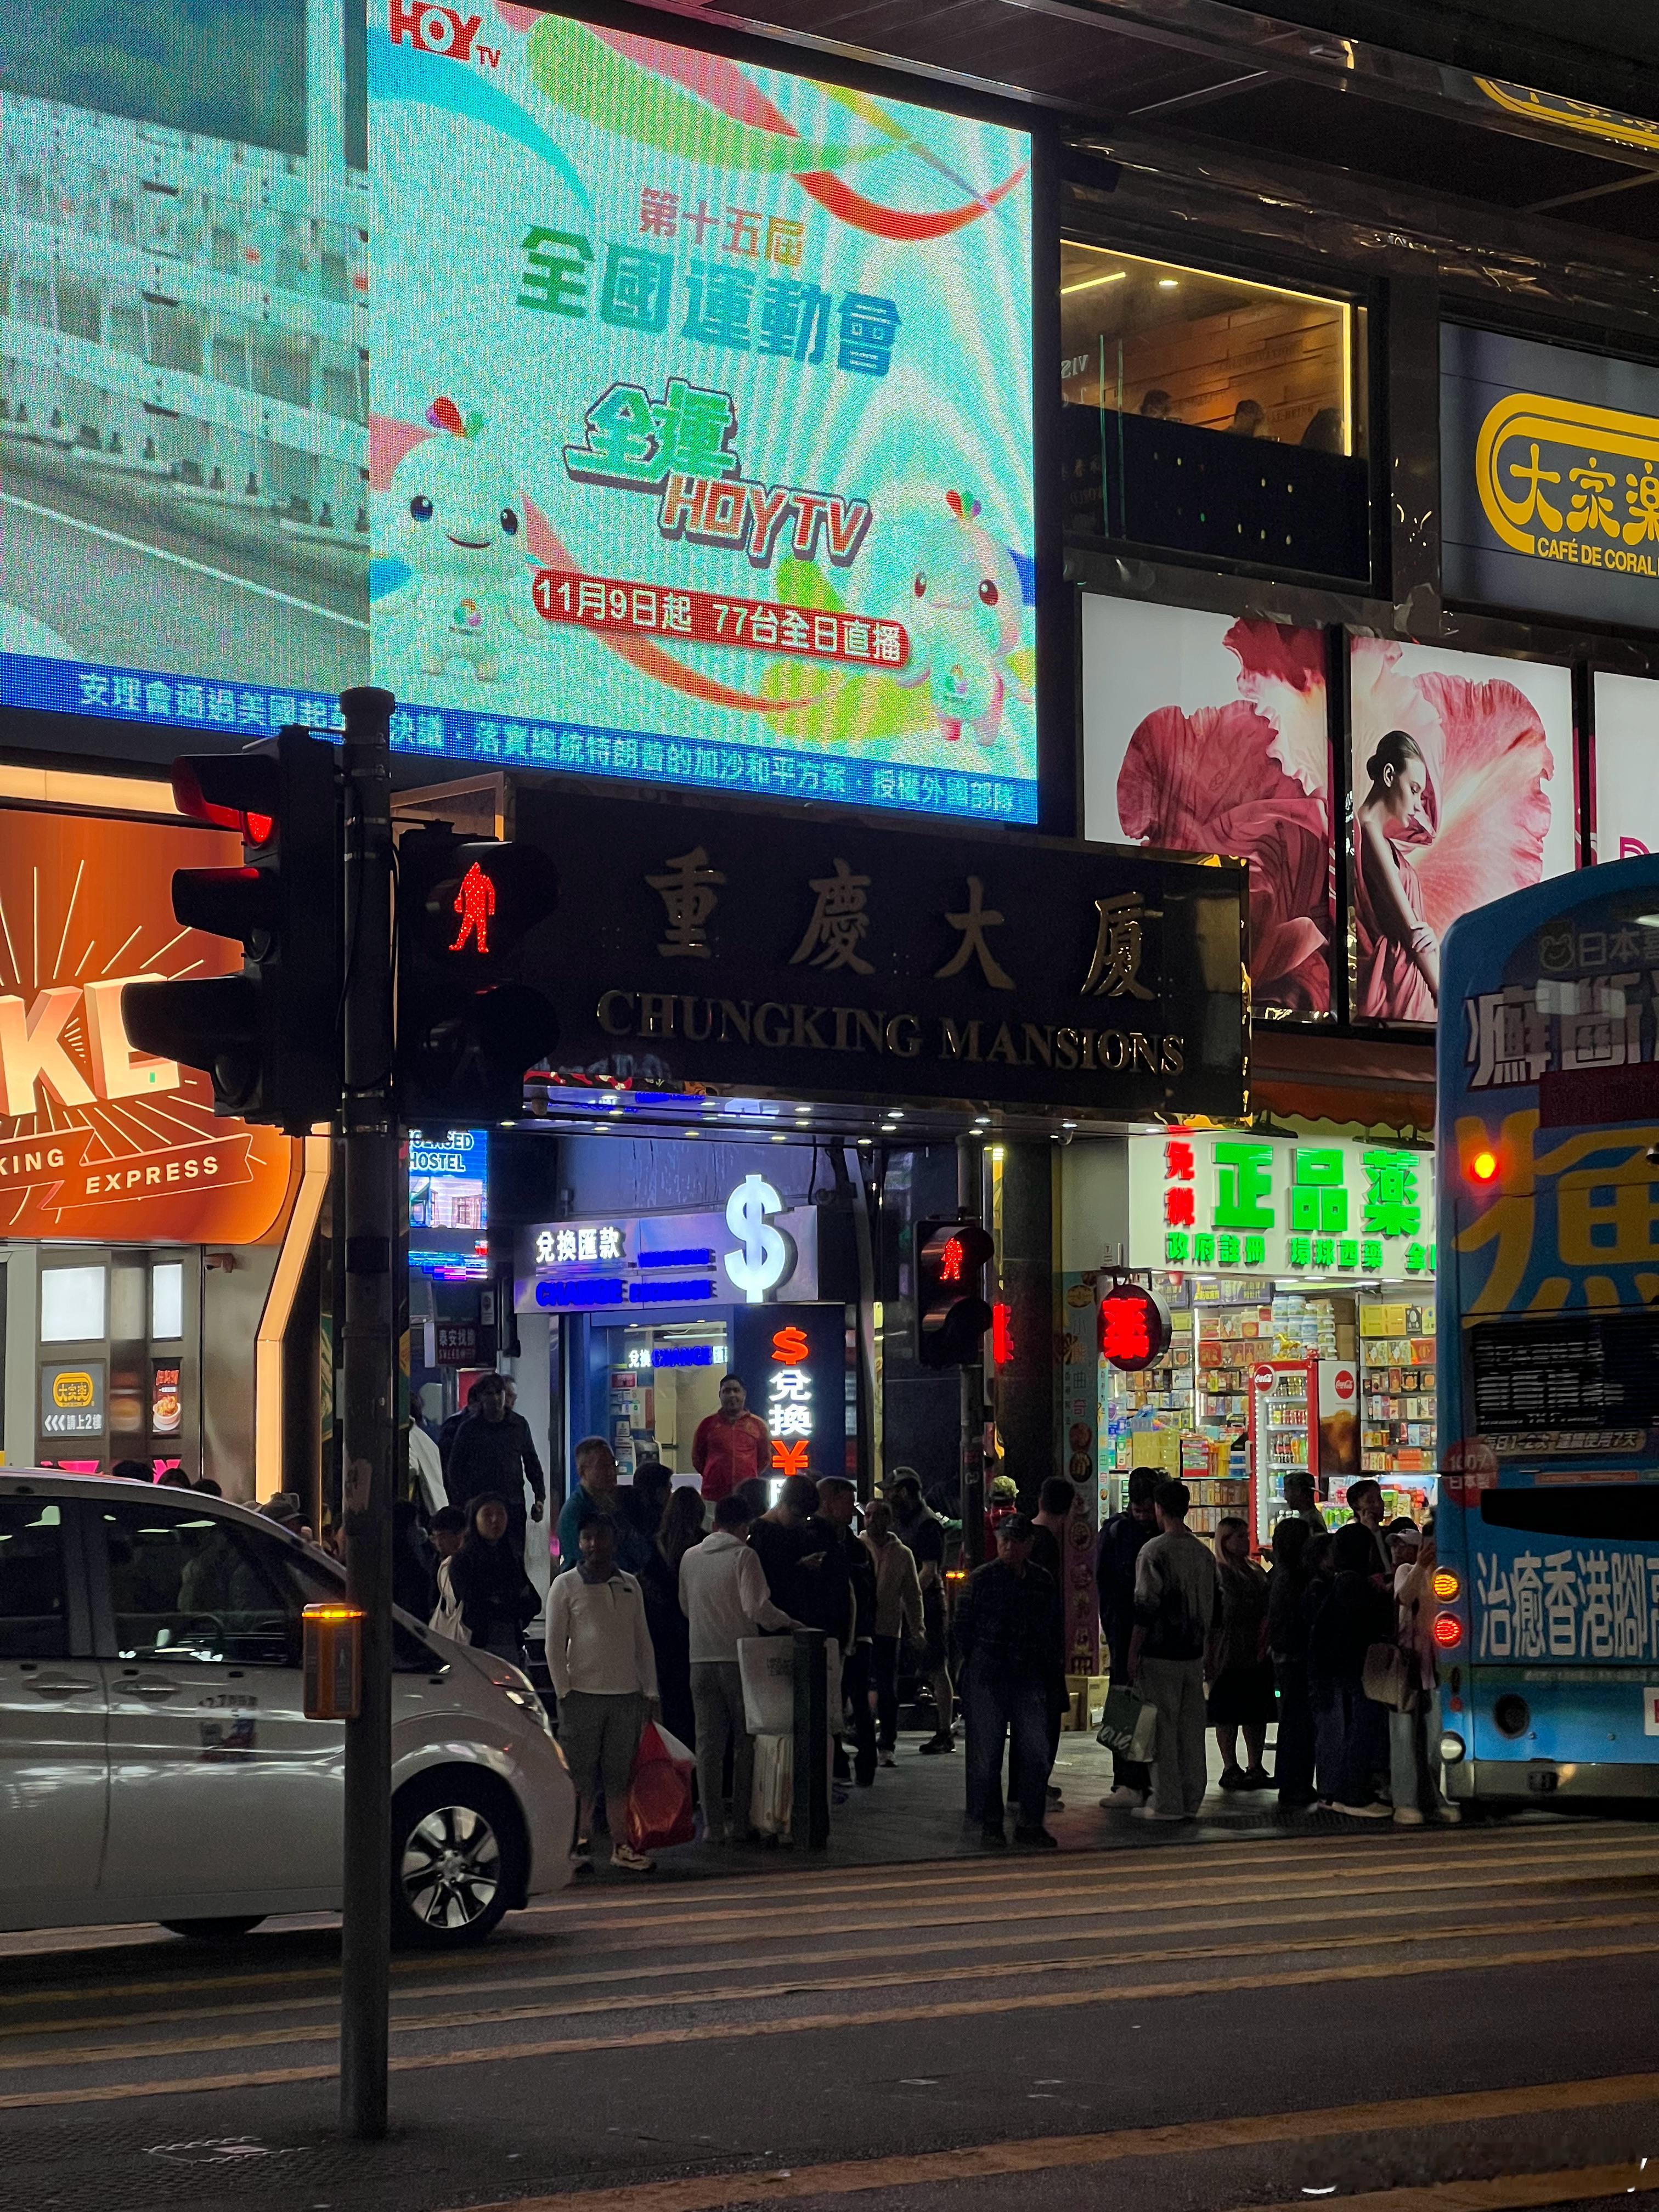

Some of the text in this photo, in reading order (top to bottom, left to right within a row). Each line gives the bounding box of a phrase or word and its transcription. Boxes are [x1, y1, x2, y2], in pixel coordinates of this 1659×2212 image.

[391, 0, 500, 67] HOY TV
[517, 224, 901, 377] 全國運動會
[1537, 537, 1578, 562] CAFÉ
[1581, 546, 1602, 567] DE
[538, 579, 901, 662] 11月9日起 77台全日直播
[596, 989, 1186, 1077] CHUNGKING MANSIONS
[86, 1156, 218, 1195] EXPRESS
[409, 1152, 466, 1171] HOSTEL
